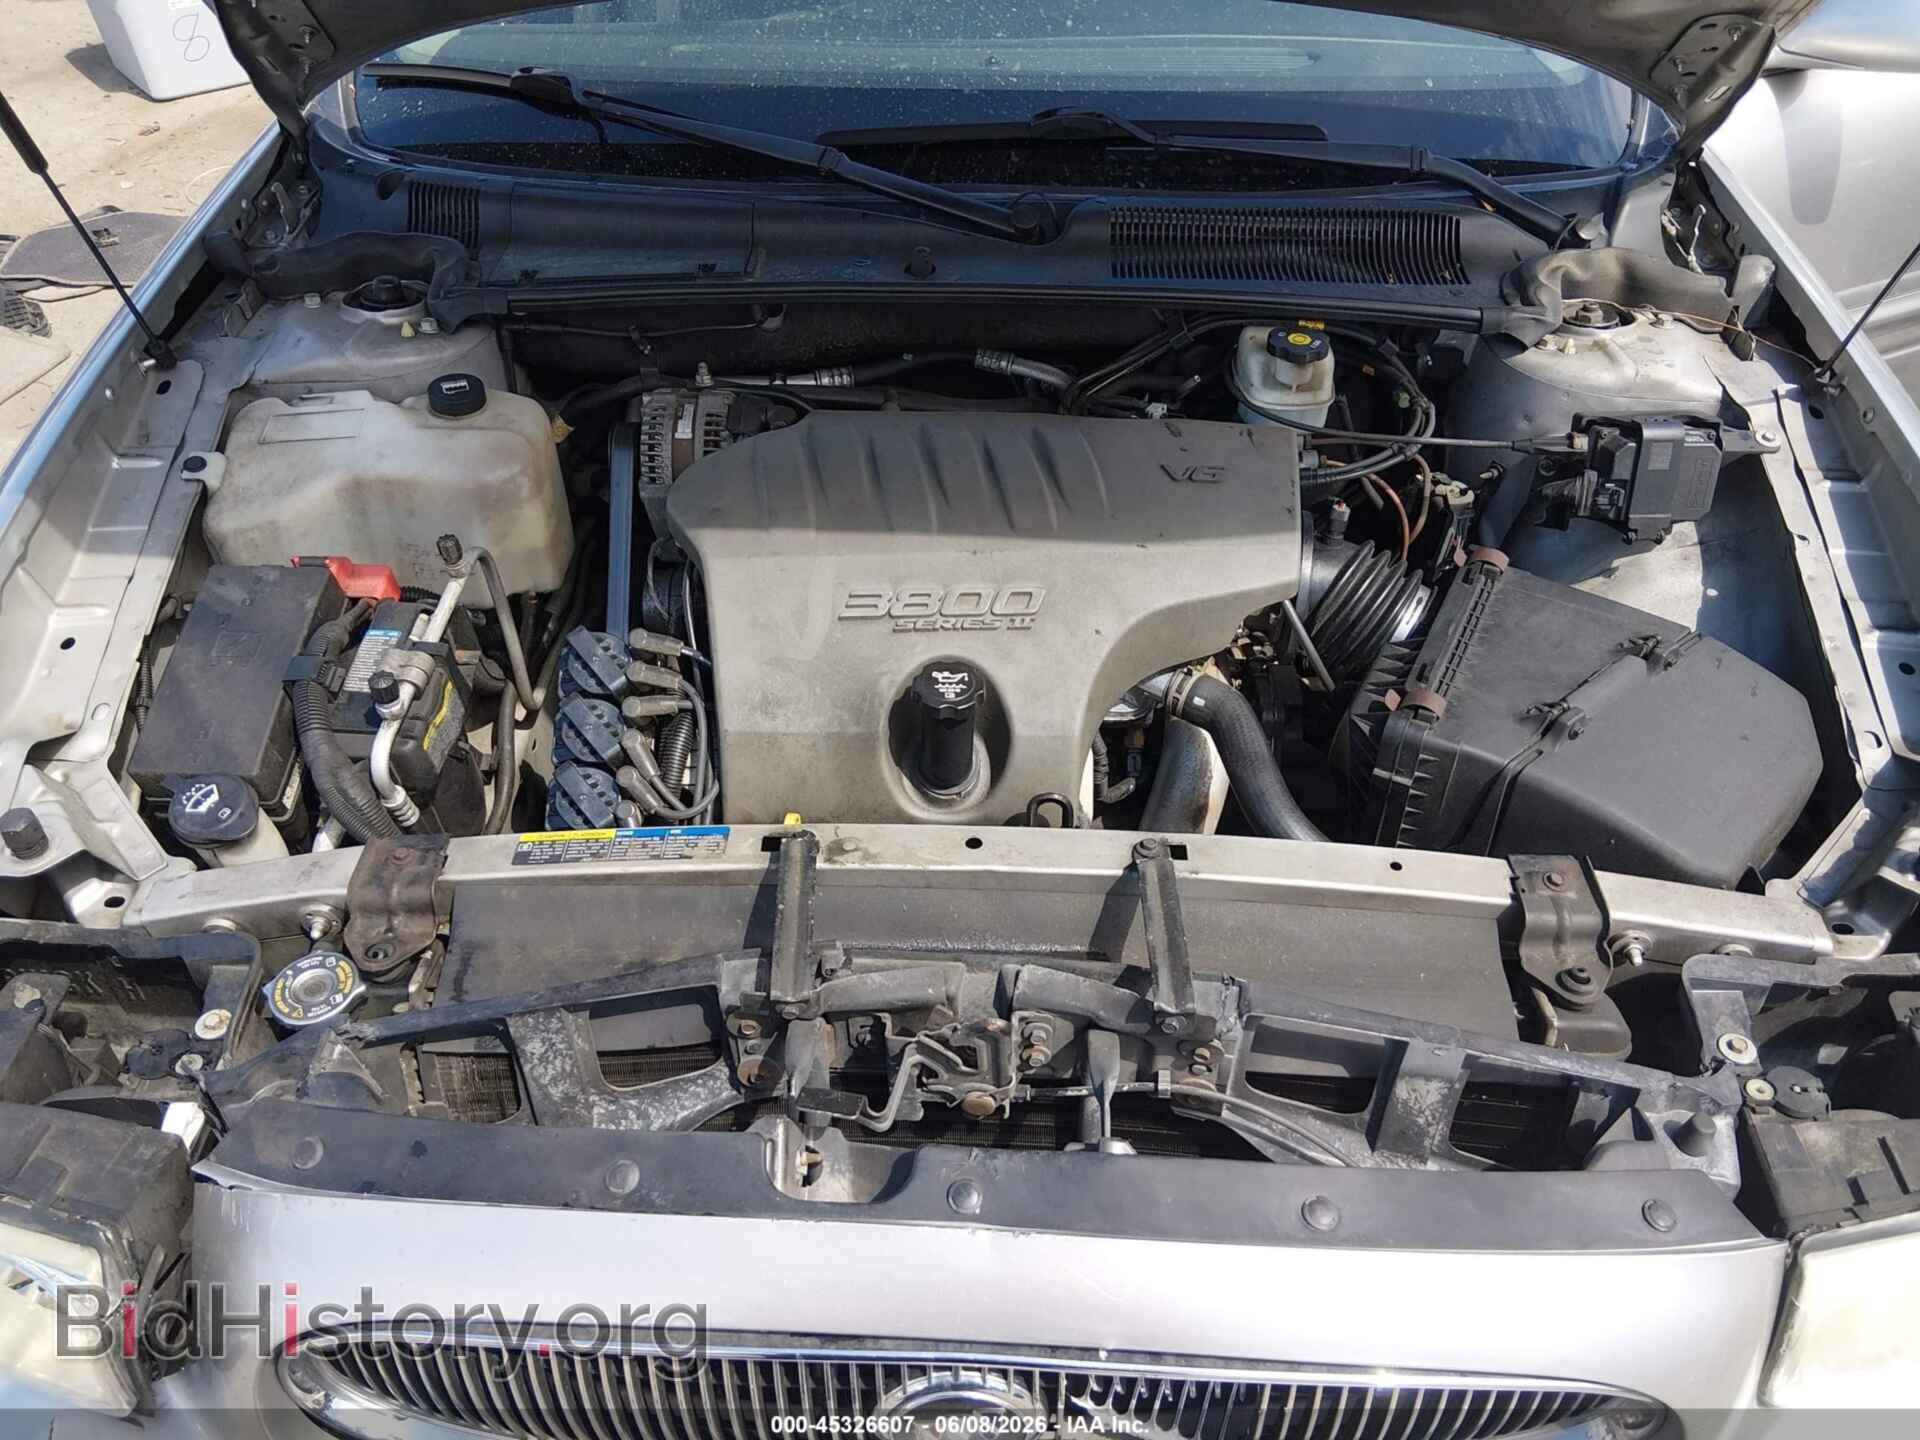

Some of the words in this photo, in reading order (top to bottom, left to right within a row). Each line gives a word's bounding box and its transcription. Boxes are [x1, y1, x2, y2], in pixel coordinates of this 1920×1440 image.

[172, 13, 210, 62] 8
[1159, 463, 1226, 484] V6
[838, 584, 1047, 621] 3800
[893, 617, 1001, 633] SERIES
[1006, 617, 1035, 631] II
